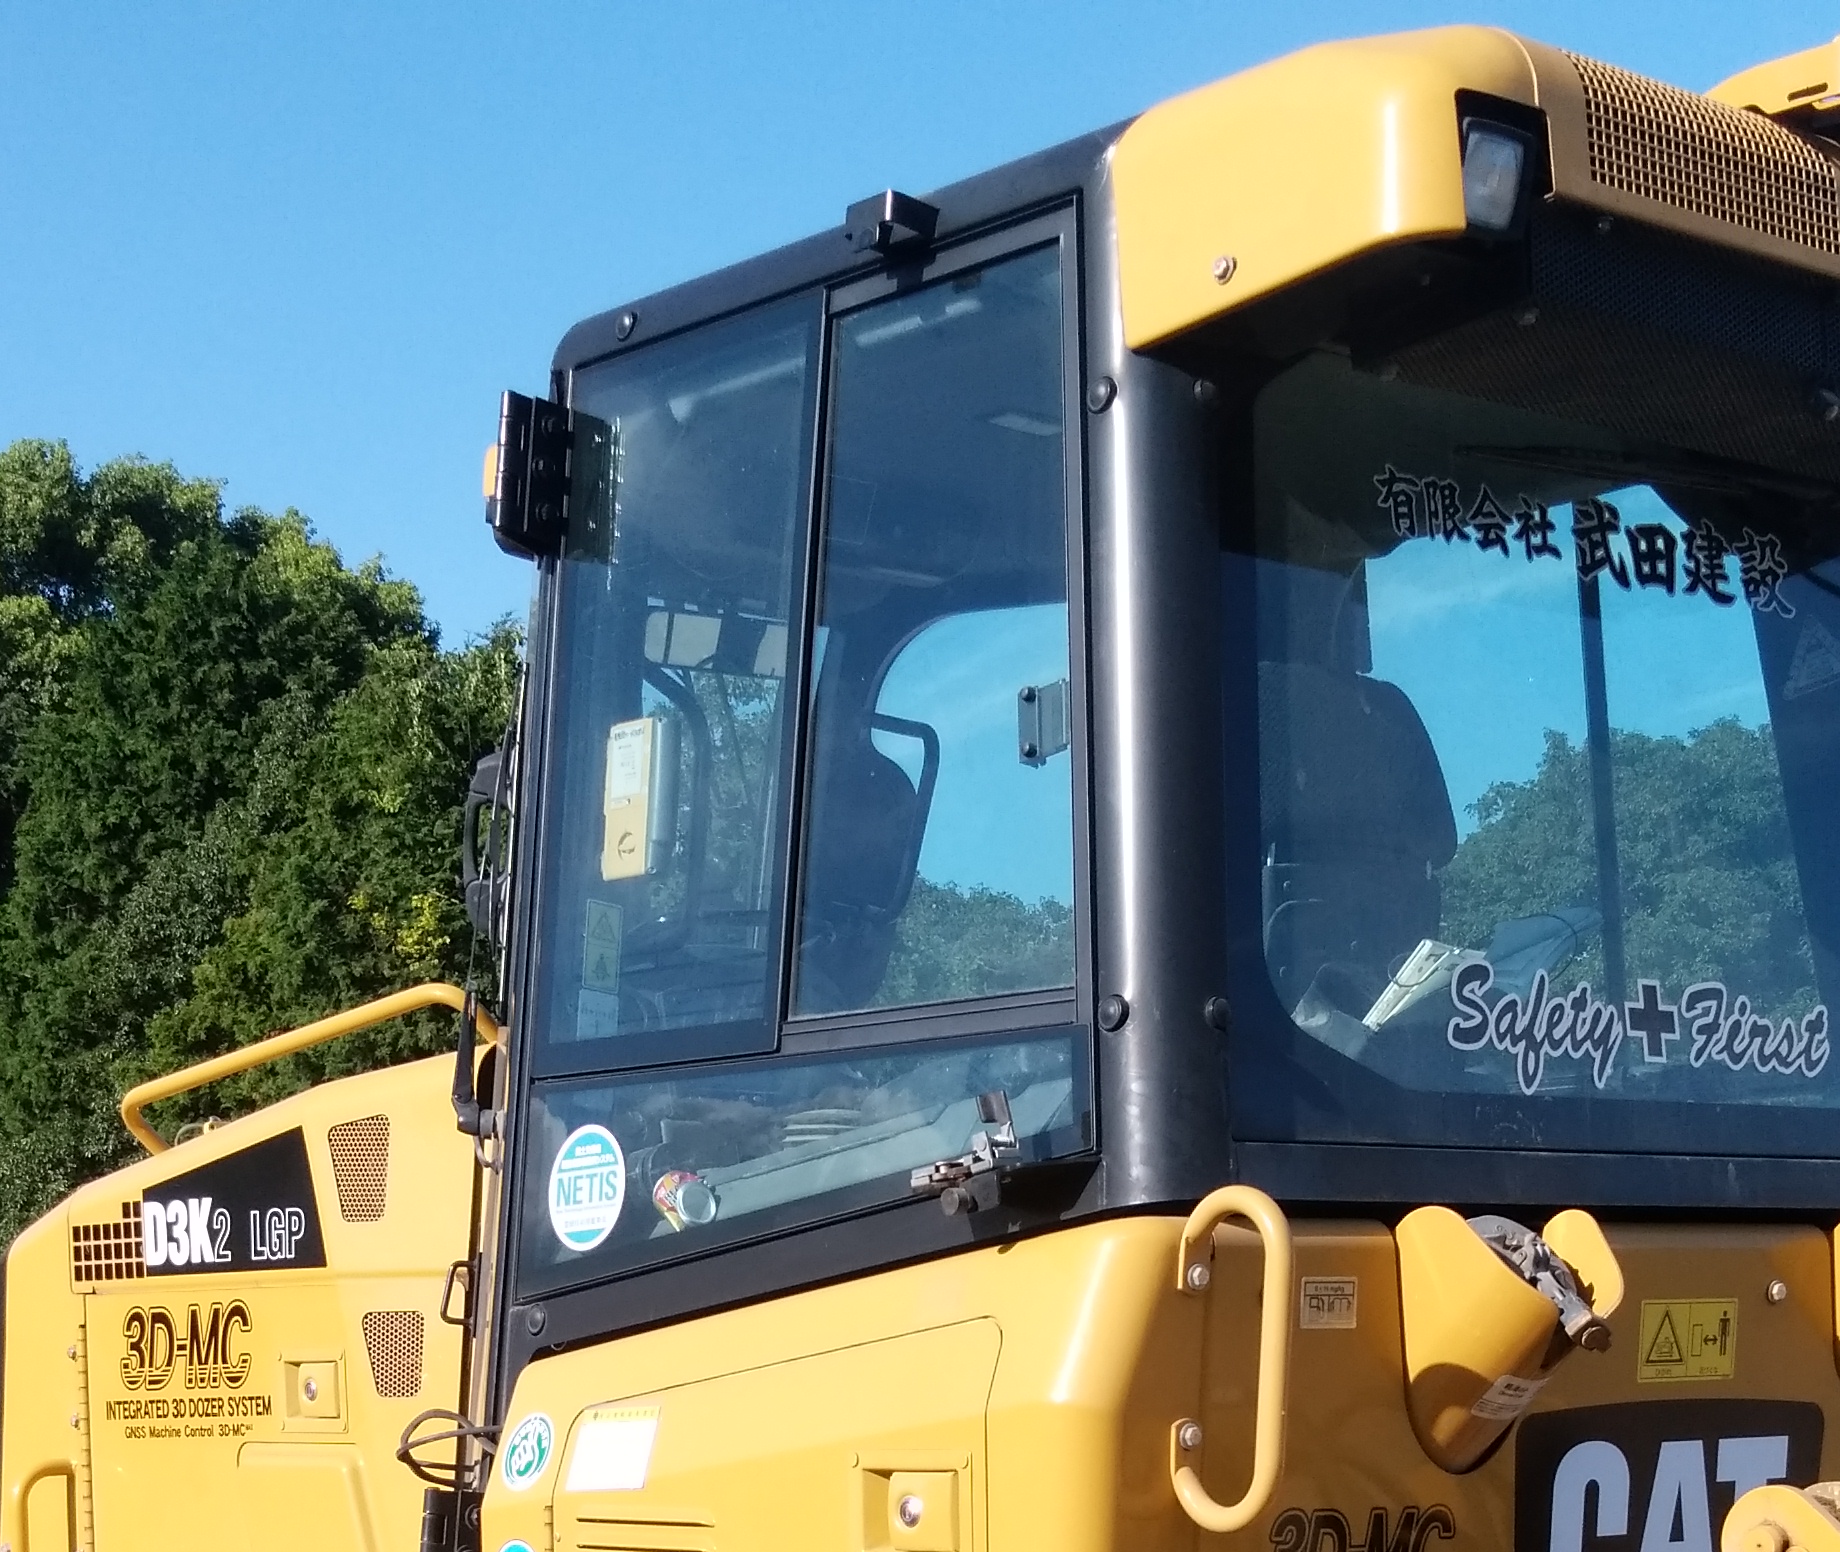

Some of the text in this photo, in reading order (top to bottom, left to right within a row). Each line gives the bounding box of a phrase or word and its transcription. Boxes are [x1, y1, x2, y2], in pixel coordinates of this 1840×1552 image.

[1446, 959, 1831, 1095] Safety First
[556, 1170, 618, 1207] NETIS
[144, 1197, 306, 1266] D3K2 LGP
[120, 1299, 253, 1391] 3D-MC
[105, 1395, 272, 1421] INTEGRATED 3D DOZER SYSTEM
[124, 1426, 146, 1439] GNSS
[149, 1425, 181, 1438] Machine
[184, 1424, 214, 1437] Control
